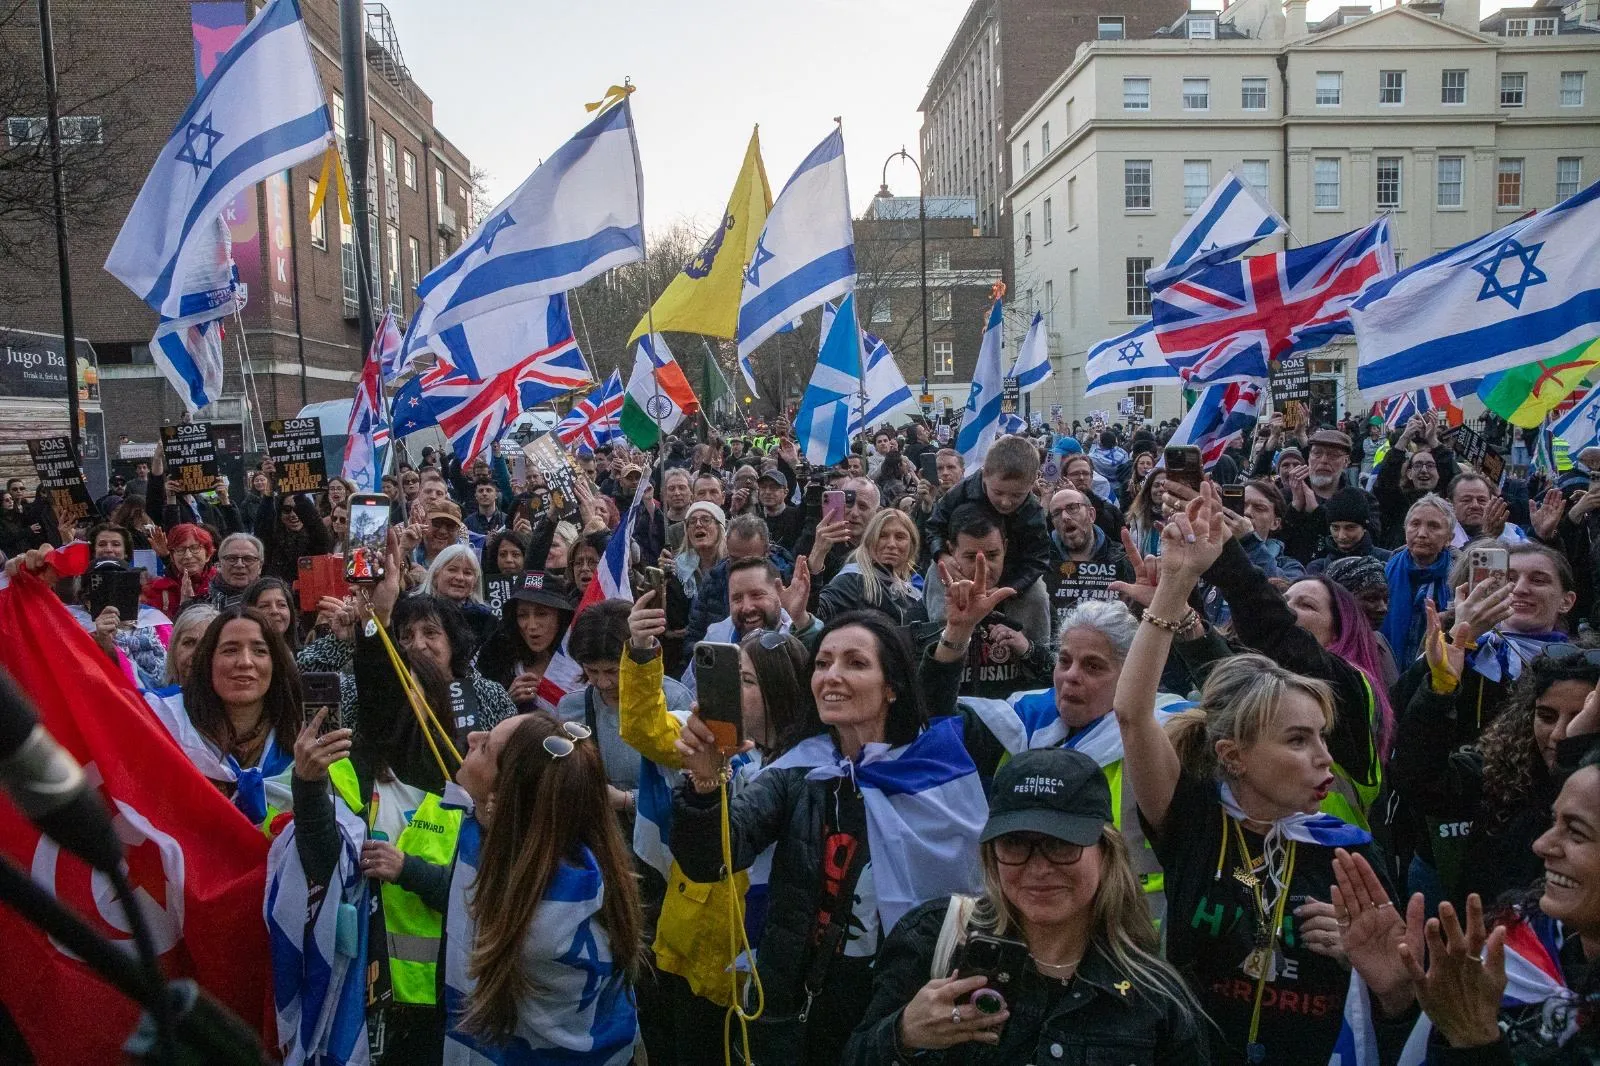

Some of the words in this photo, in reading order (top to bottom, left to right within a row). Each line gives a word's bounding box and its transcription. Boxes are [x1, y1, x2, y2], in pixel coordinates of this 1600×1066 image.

[6, 346, 42, 369] Jugo
[46, 350, 68, 367] Ba
[1281, 359, 1304, 369] SOAS
[177, 424, 207, 436] SOAS
[284, 419, 315, 430] SOAS
[39, 438, 66, 451] SOAS
[269, 440, 288, 449] JEWS
[271, 455, 290, 463] STOP
[306, 451, 322, 459] LIES
[1078, 563, 1117, 576] SOAS
[525, 575, 545, 583] FCK
[1055, 588, 1080, 598] JEWS
[1081, 589, 1089, 598] &
[1091, 589, 1120, 599] ARABS
[489, 581, 503, 620] SOAS
[1025, 775, 1064, 788] TRIBECA
[1014, 784, 1057, 795] FESTIVAL
[407, 819, 445, 834] STEWARD
